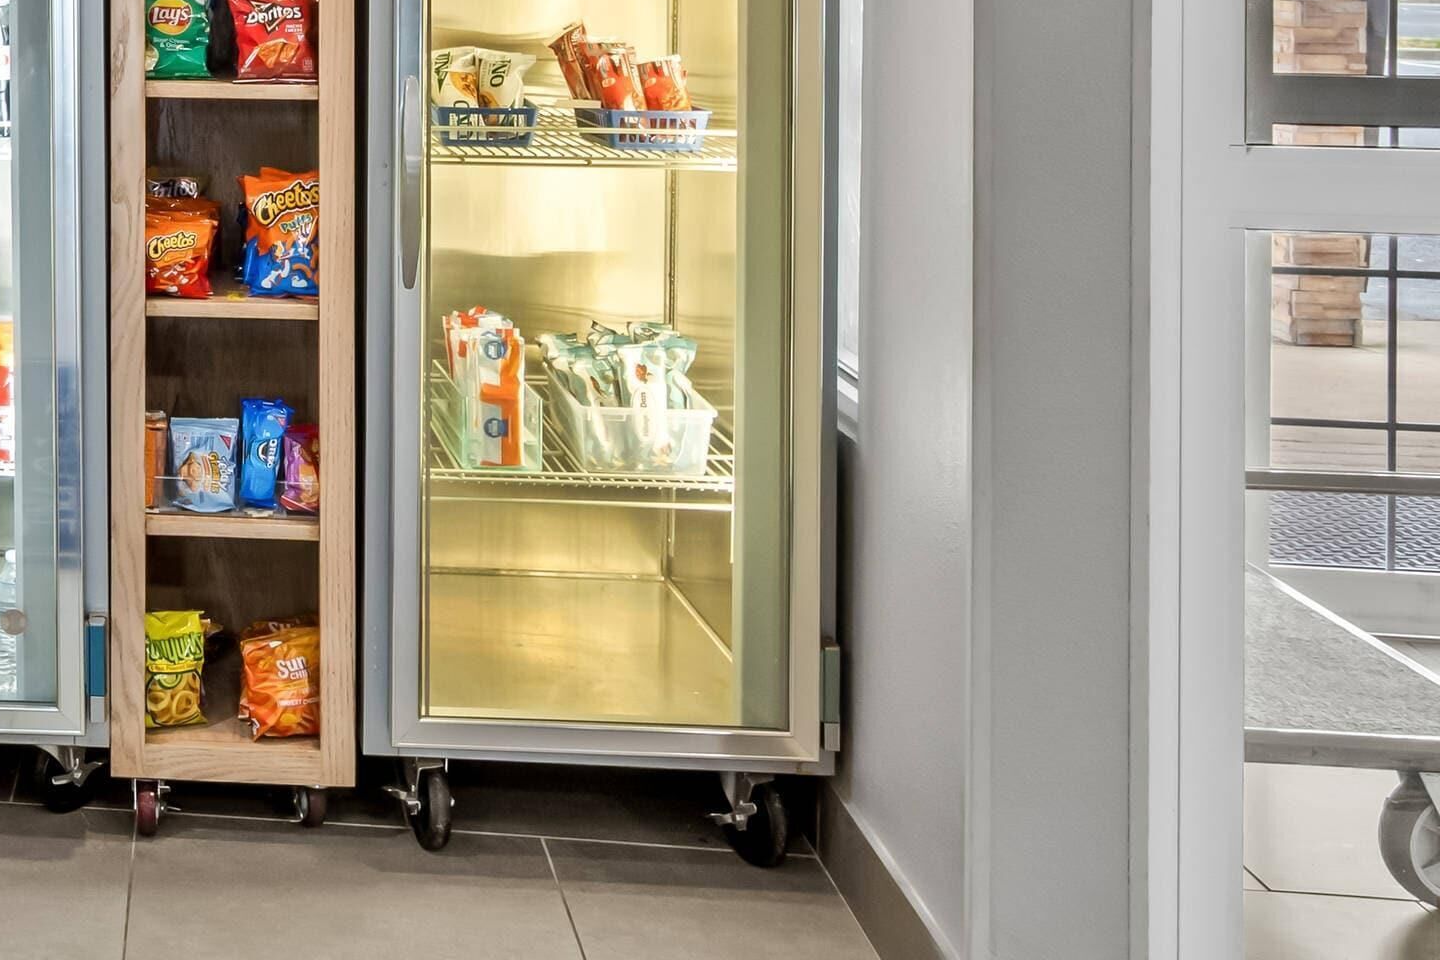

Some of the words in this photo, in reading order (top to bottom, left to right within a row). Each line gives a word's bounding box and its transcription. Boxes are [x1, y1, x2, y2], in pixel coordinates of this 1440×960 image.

[152, 7, 190, 26] Lay's
[246, 6, 302, 25] Doritos
[254, 182, 320, 227] Cheetos
[148, 231, 196, 260] Cheetos
[267, 439, 278, 469] OREO
